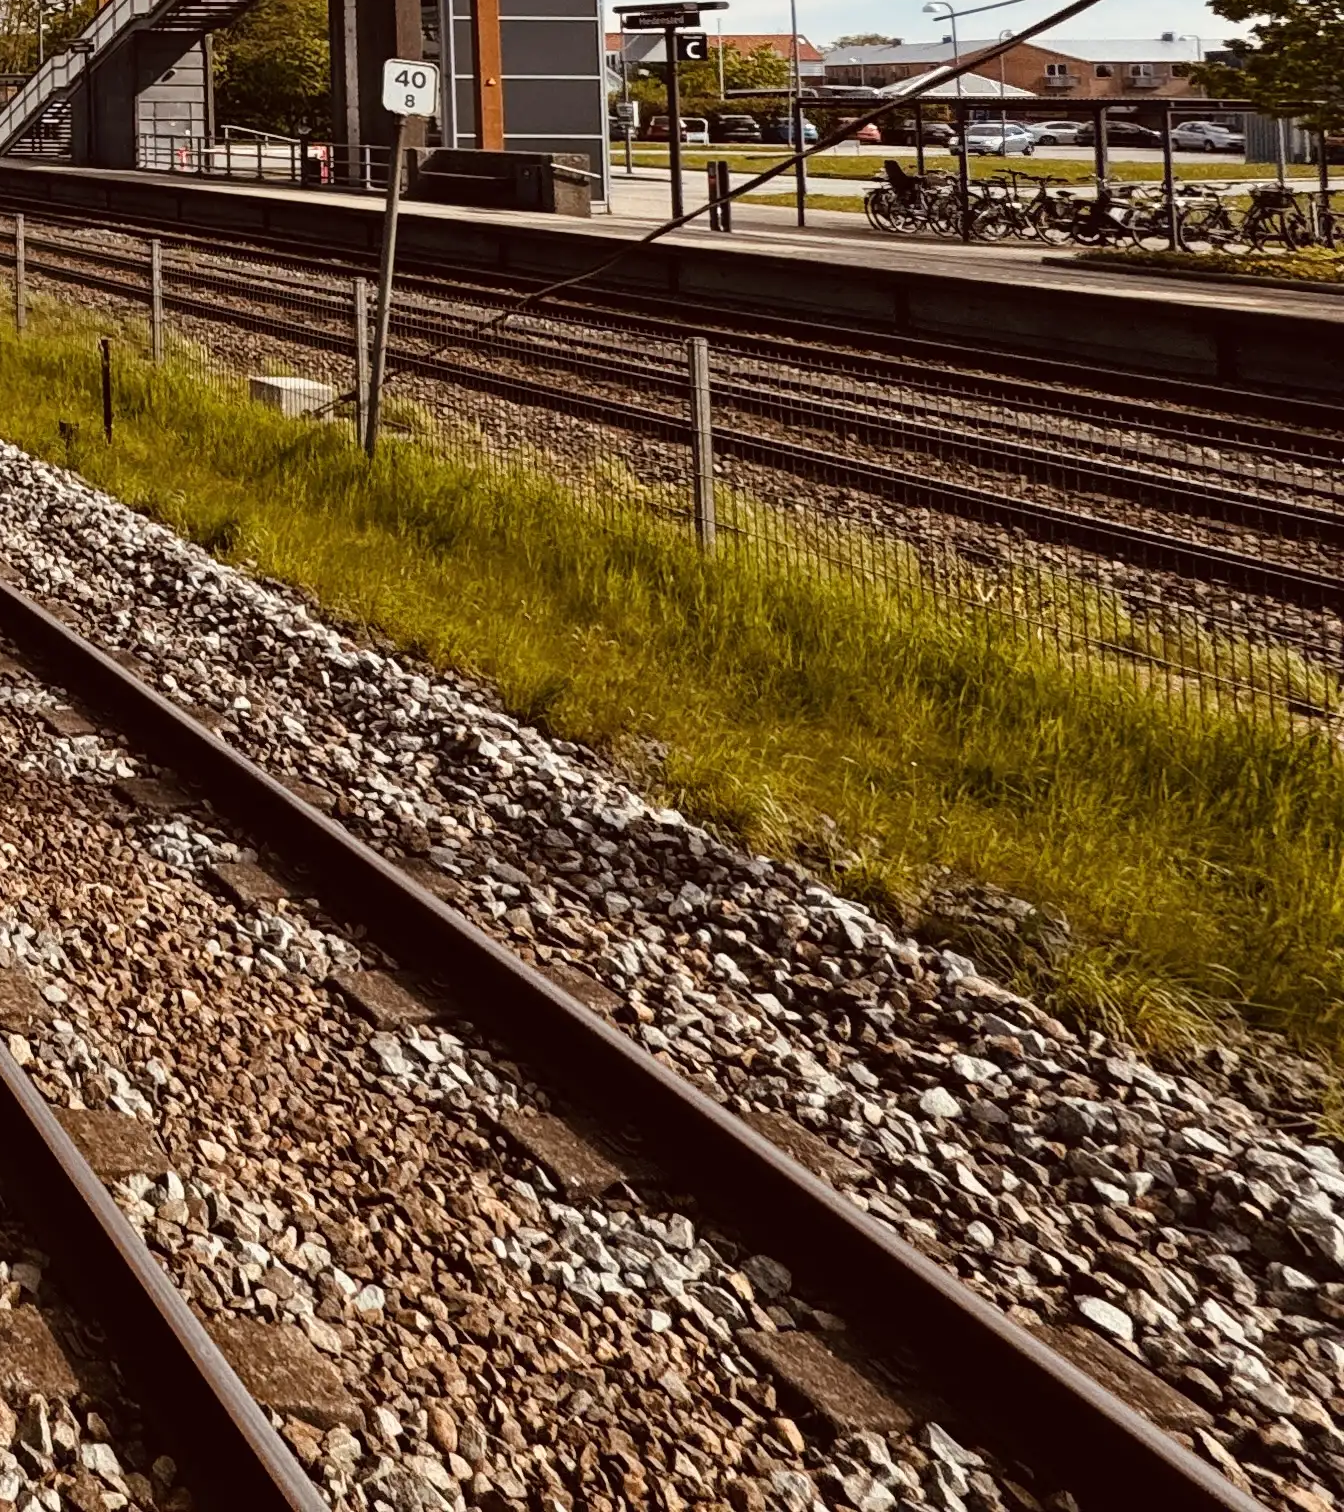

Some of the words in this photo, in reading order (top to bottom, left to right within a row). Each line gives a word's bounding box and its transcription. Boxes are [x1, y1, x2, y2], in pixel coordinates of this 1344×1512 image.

[686, 41, 701, 59] C
[394, 69, 427, 89] 40
[404, 94, 416, 108] 8
